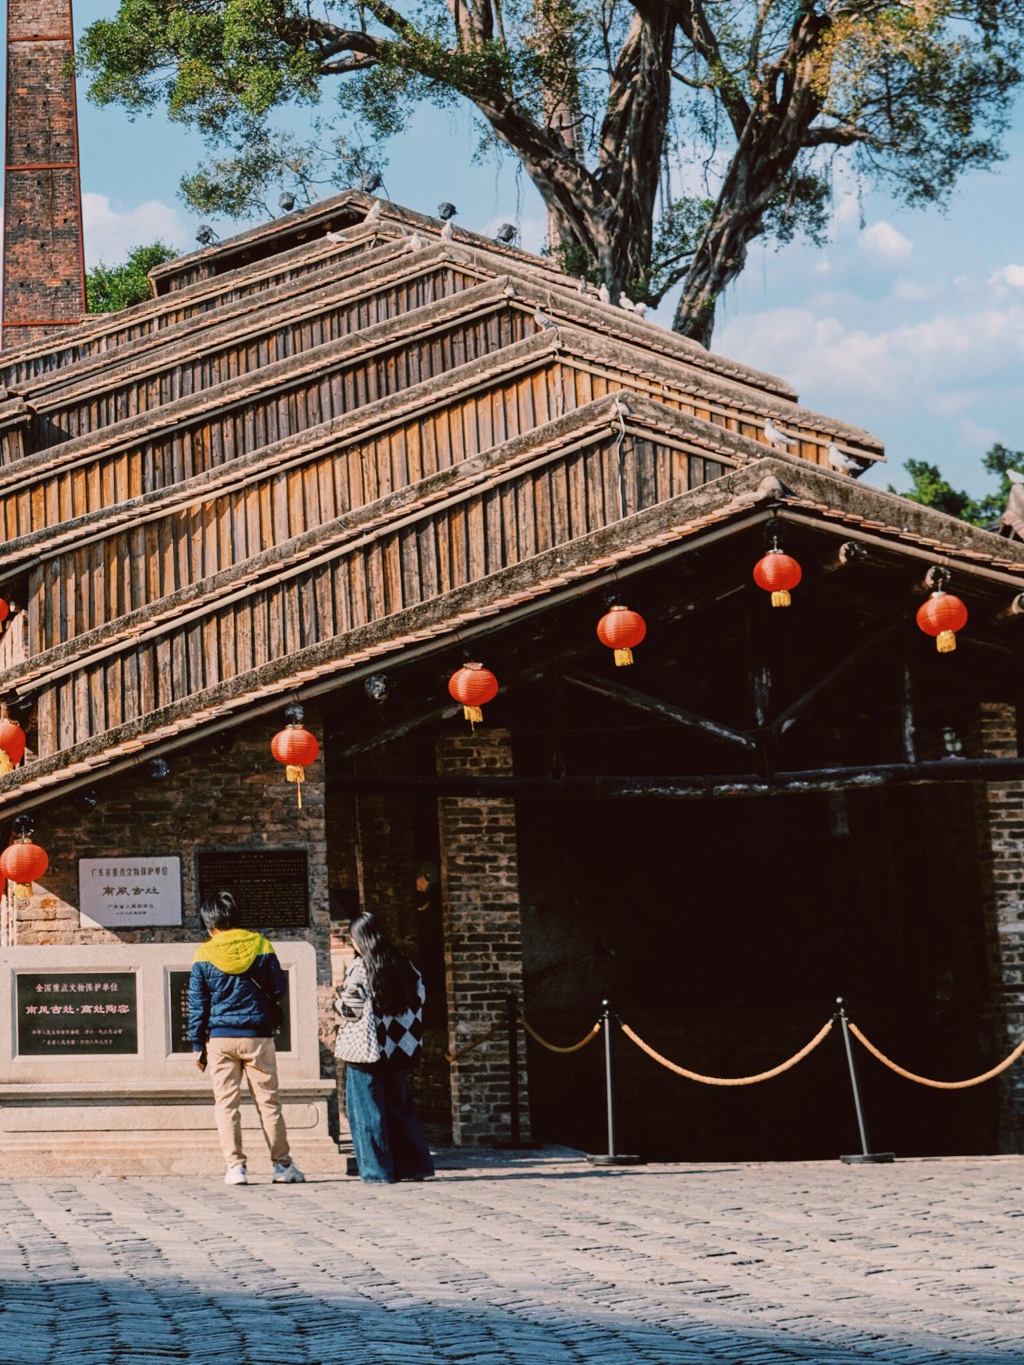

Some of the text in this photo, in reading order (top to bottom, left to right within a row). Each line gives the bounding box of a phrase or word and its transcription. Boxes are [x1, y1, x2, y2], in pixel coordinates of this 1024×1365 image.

[91, 866, 168, 877] 广东省重点文物保护单位
[35, 983, 119, 993] 全国重点文物保护单位
